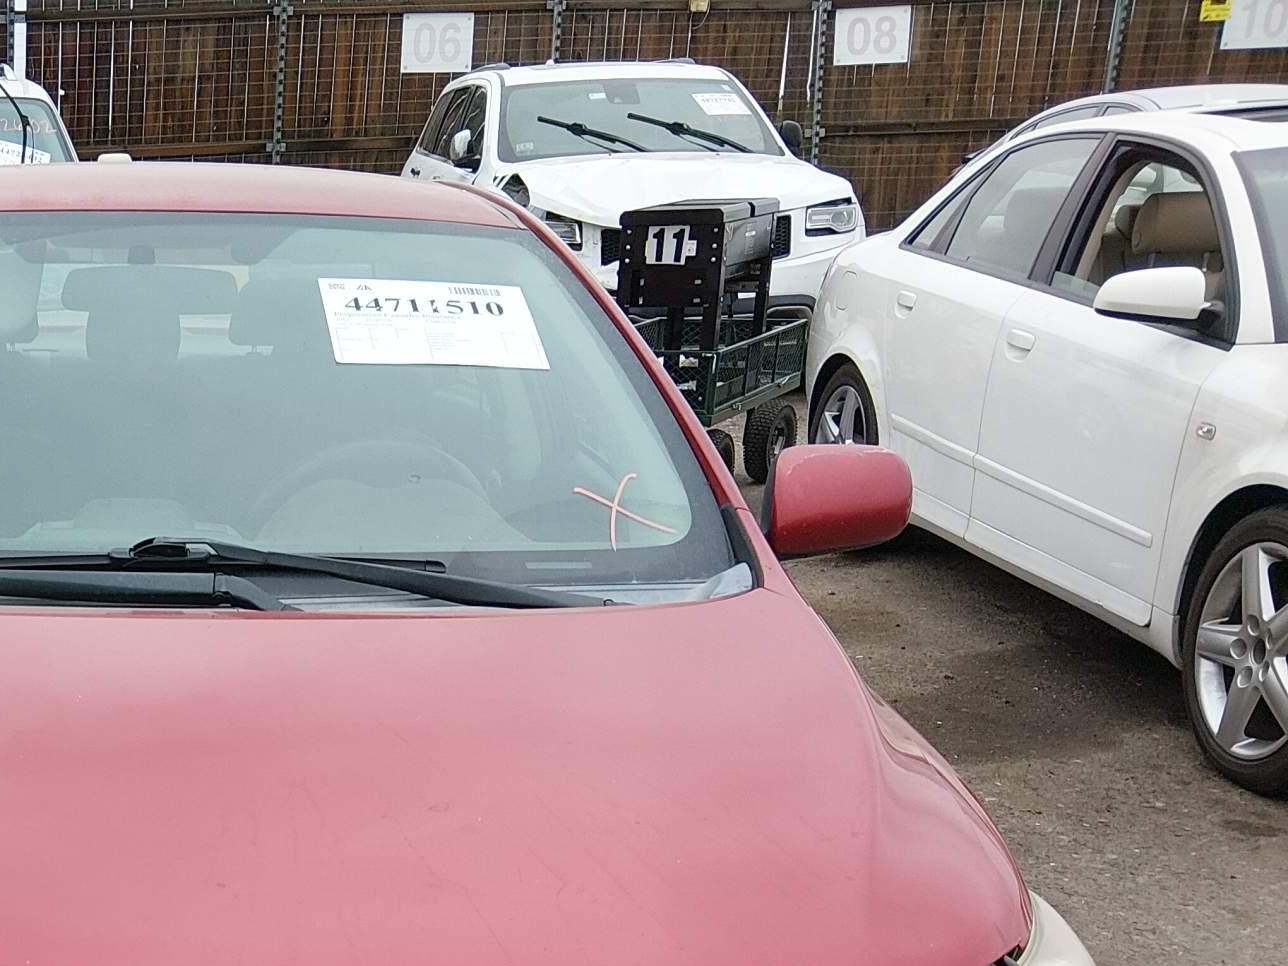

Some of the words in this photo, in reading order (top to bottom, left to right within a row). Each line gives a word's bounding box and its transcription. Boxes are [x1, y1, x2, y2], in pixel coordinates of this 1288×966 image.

[847, 16, 897, 55] 08
[1241, 0, 1288, 38] 10
[413, 22, 461, 63] 06
[653, 228, 686, 263] 11
[345, 297, 504, 316] 44711510
